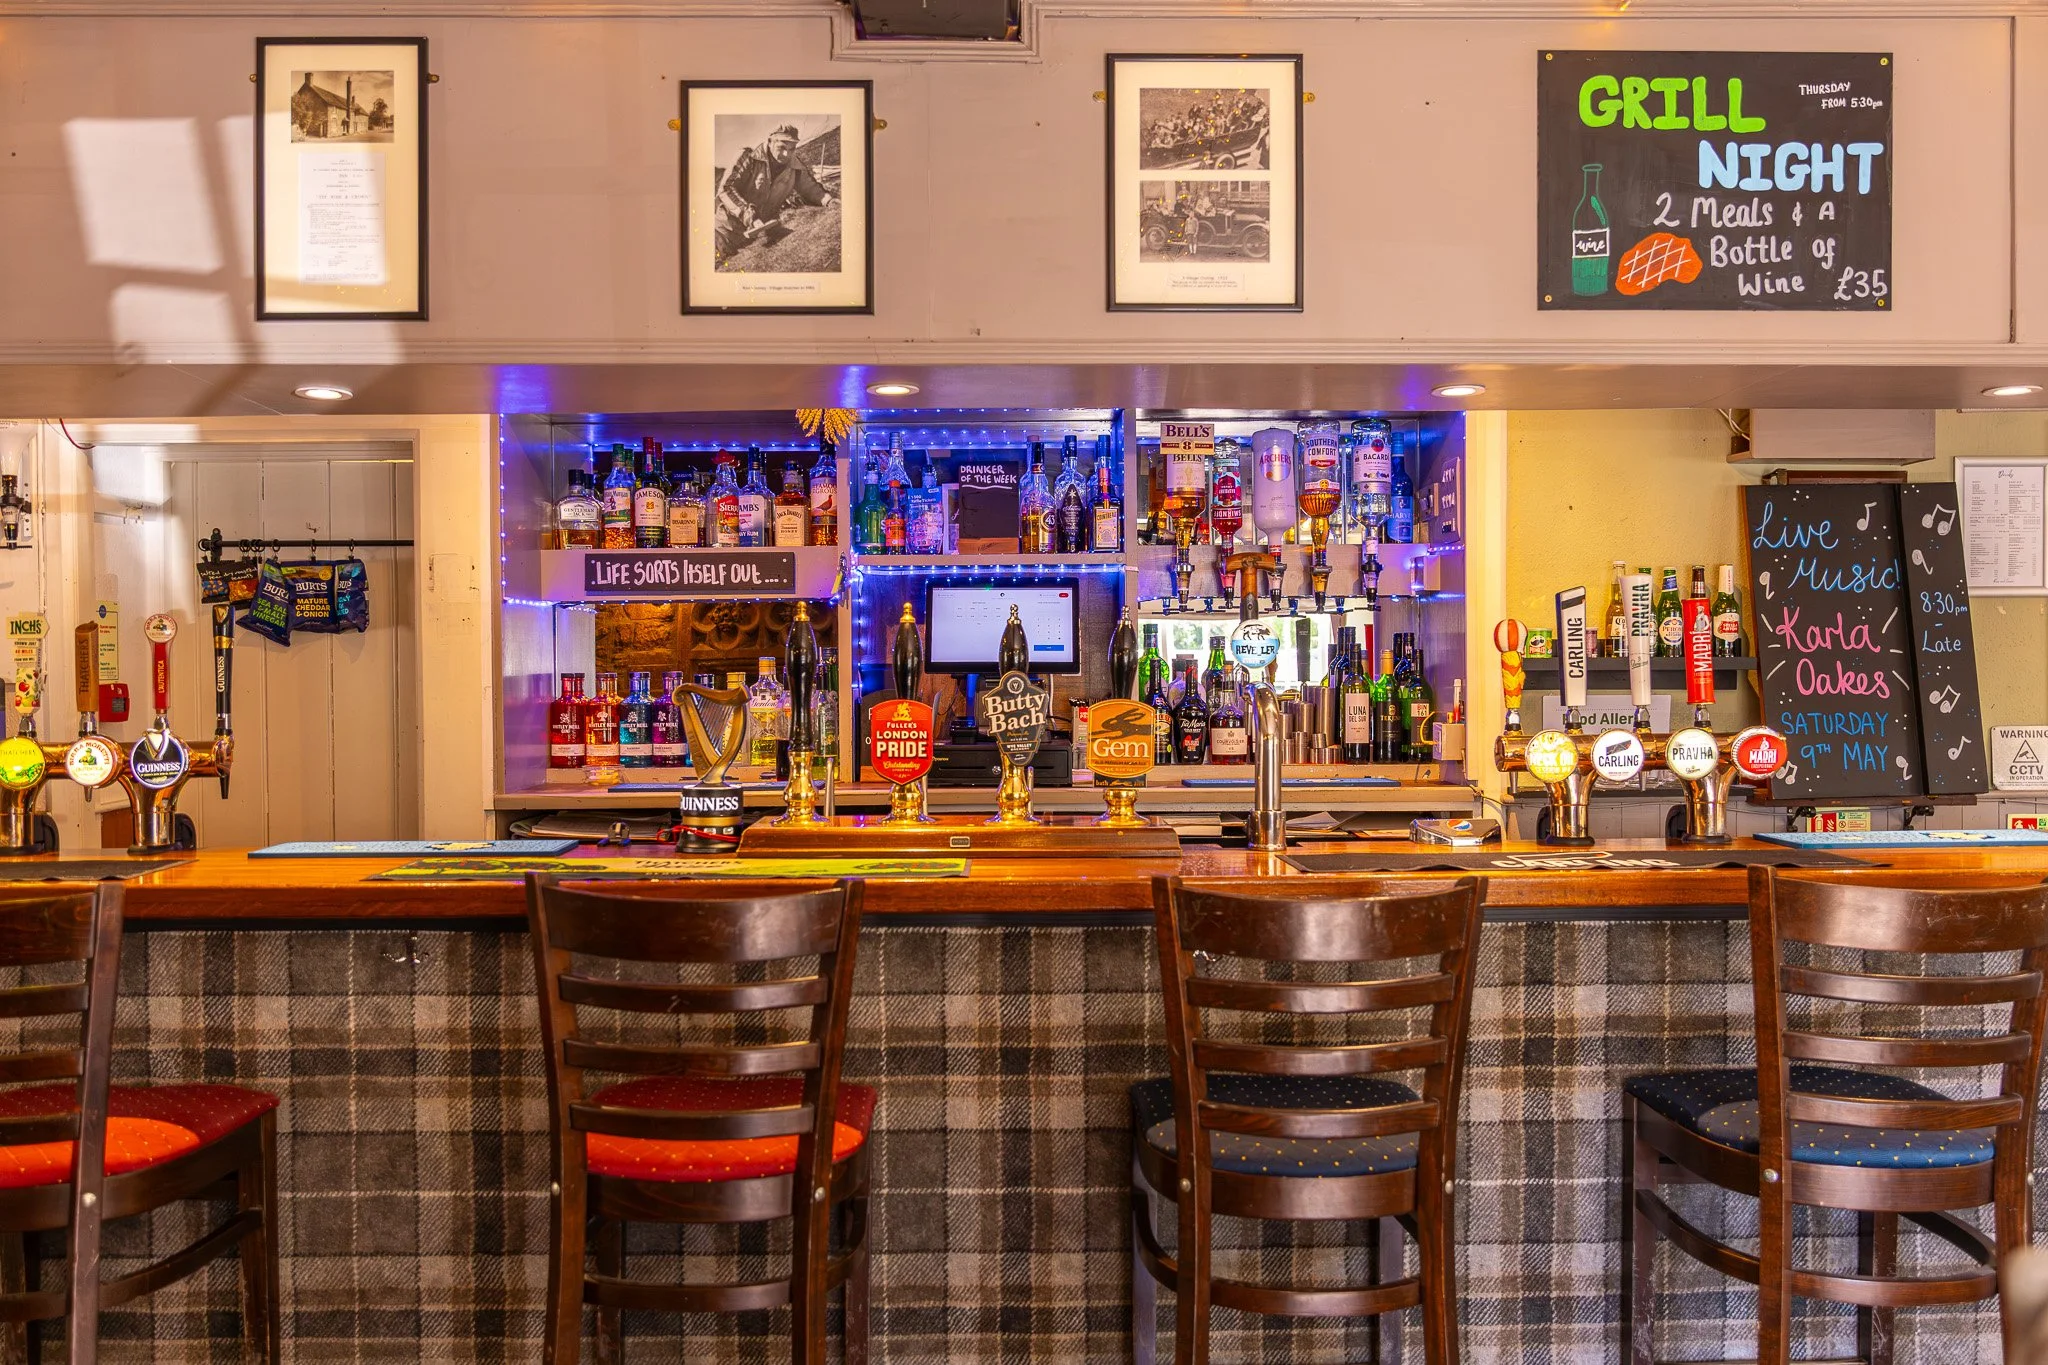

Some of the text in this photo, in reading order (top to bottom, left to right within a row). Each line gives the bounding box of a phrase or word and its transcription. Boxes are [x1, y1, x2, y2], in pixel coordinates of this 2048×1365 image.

[1799, 82, 1851, 96] THURSDAY
[1578, 75, 1766, 133] GRILL
[1821, 97, 1846, 110] FROM
[1699, 139, 1884, 194] NIGHT
[1653, 192, 1680, 228] 2
[1691, 197, 1773, 228] Meals
[1819, 201, 1835, 220] A
[1576, 239, 1605, 253] wine
[1710, 235, 1836, 269] Bottle of
[1738, 266, 1888, 301] Wine £35
[1166, 424, 1210, 438] BELL'S
[1182, 441, 1192, 451] 8
[1306, 437, 1338, 449] SOUTHERN
[1259, 454, 1291, 466] ARCHERS
[1308, 448, 1336, 457] COMFORT
[960, 465, 1004, 475] DRINKER
[960, 474, 1017, 484] OF THE WEEK
[636, 490, 664, 500] JAMESON
[738, 503, 760, 512] AMB'S
[1044, 514, 1055, 525] 43
[1753, 501, 1839, 550] Live
[633, 560, 680, 585] SORTS
[1788, 556, 1900, 593] Music!
[295, 582, 327, 592] BURTS
[257, 598, 288, 614] SEA SAL
[1632, 583, 1649, 637] PRAVHA
[10, 619, 42, 635] INCH'S
[252, 611, 286, 629] VINEGAR
[1567, 617, 1584, 678] CARLING
[1922, 630, 1962, 653] Late
[79, 639, 89, 694] THATCHERS
[216, 655, 225, 692] GUINNESS
[1796, 657, 1890, 699] Oakes
[985, 693, 1046, 716] Butty
[1349, 706, 1366, 715] LUNA
[989, 707, 1046, 734] Bach
[1781, 711, 1889, 737] SATURDAY
[876, 731, 927, 739] LONDON
[876, 741, 927, 758] PRIDE
[1093, 738, 1150, 758] Gem
[1672, 747, 1713, 760] PRAVHA
[1598, 755, 1639, 767] CARLING
[1843, 741, 1888, 772] MAY
[137, 762, 181, 773] GUINNESS
[883, 761, 920, 770] Outstanding
[2009, 765, 2044, 775] CCTV
